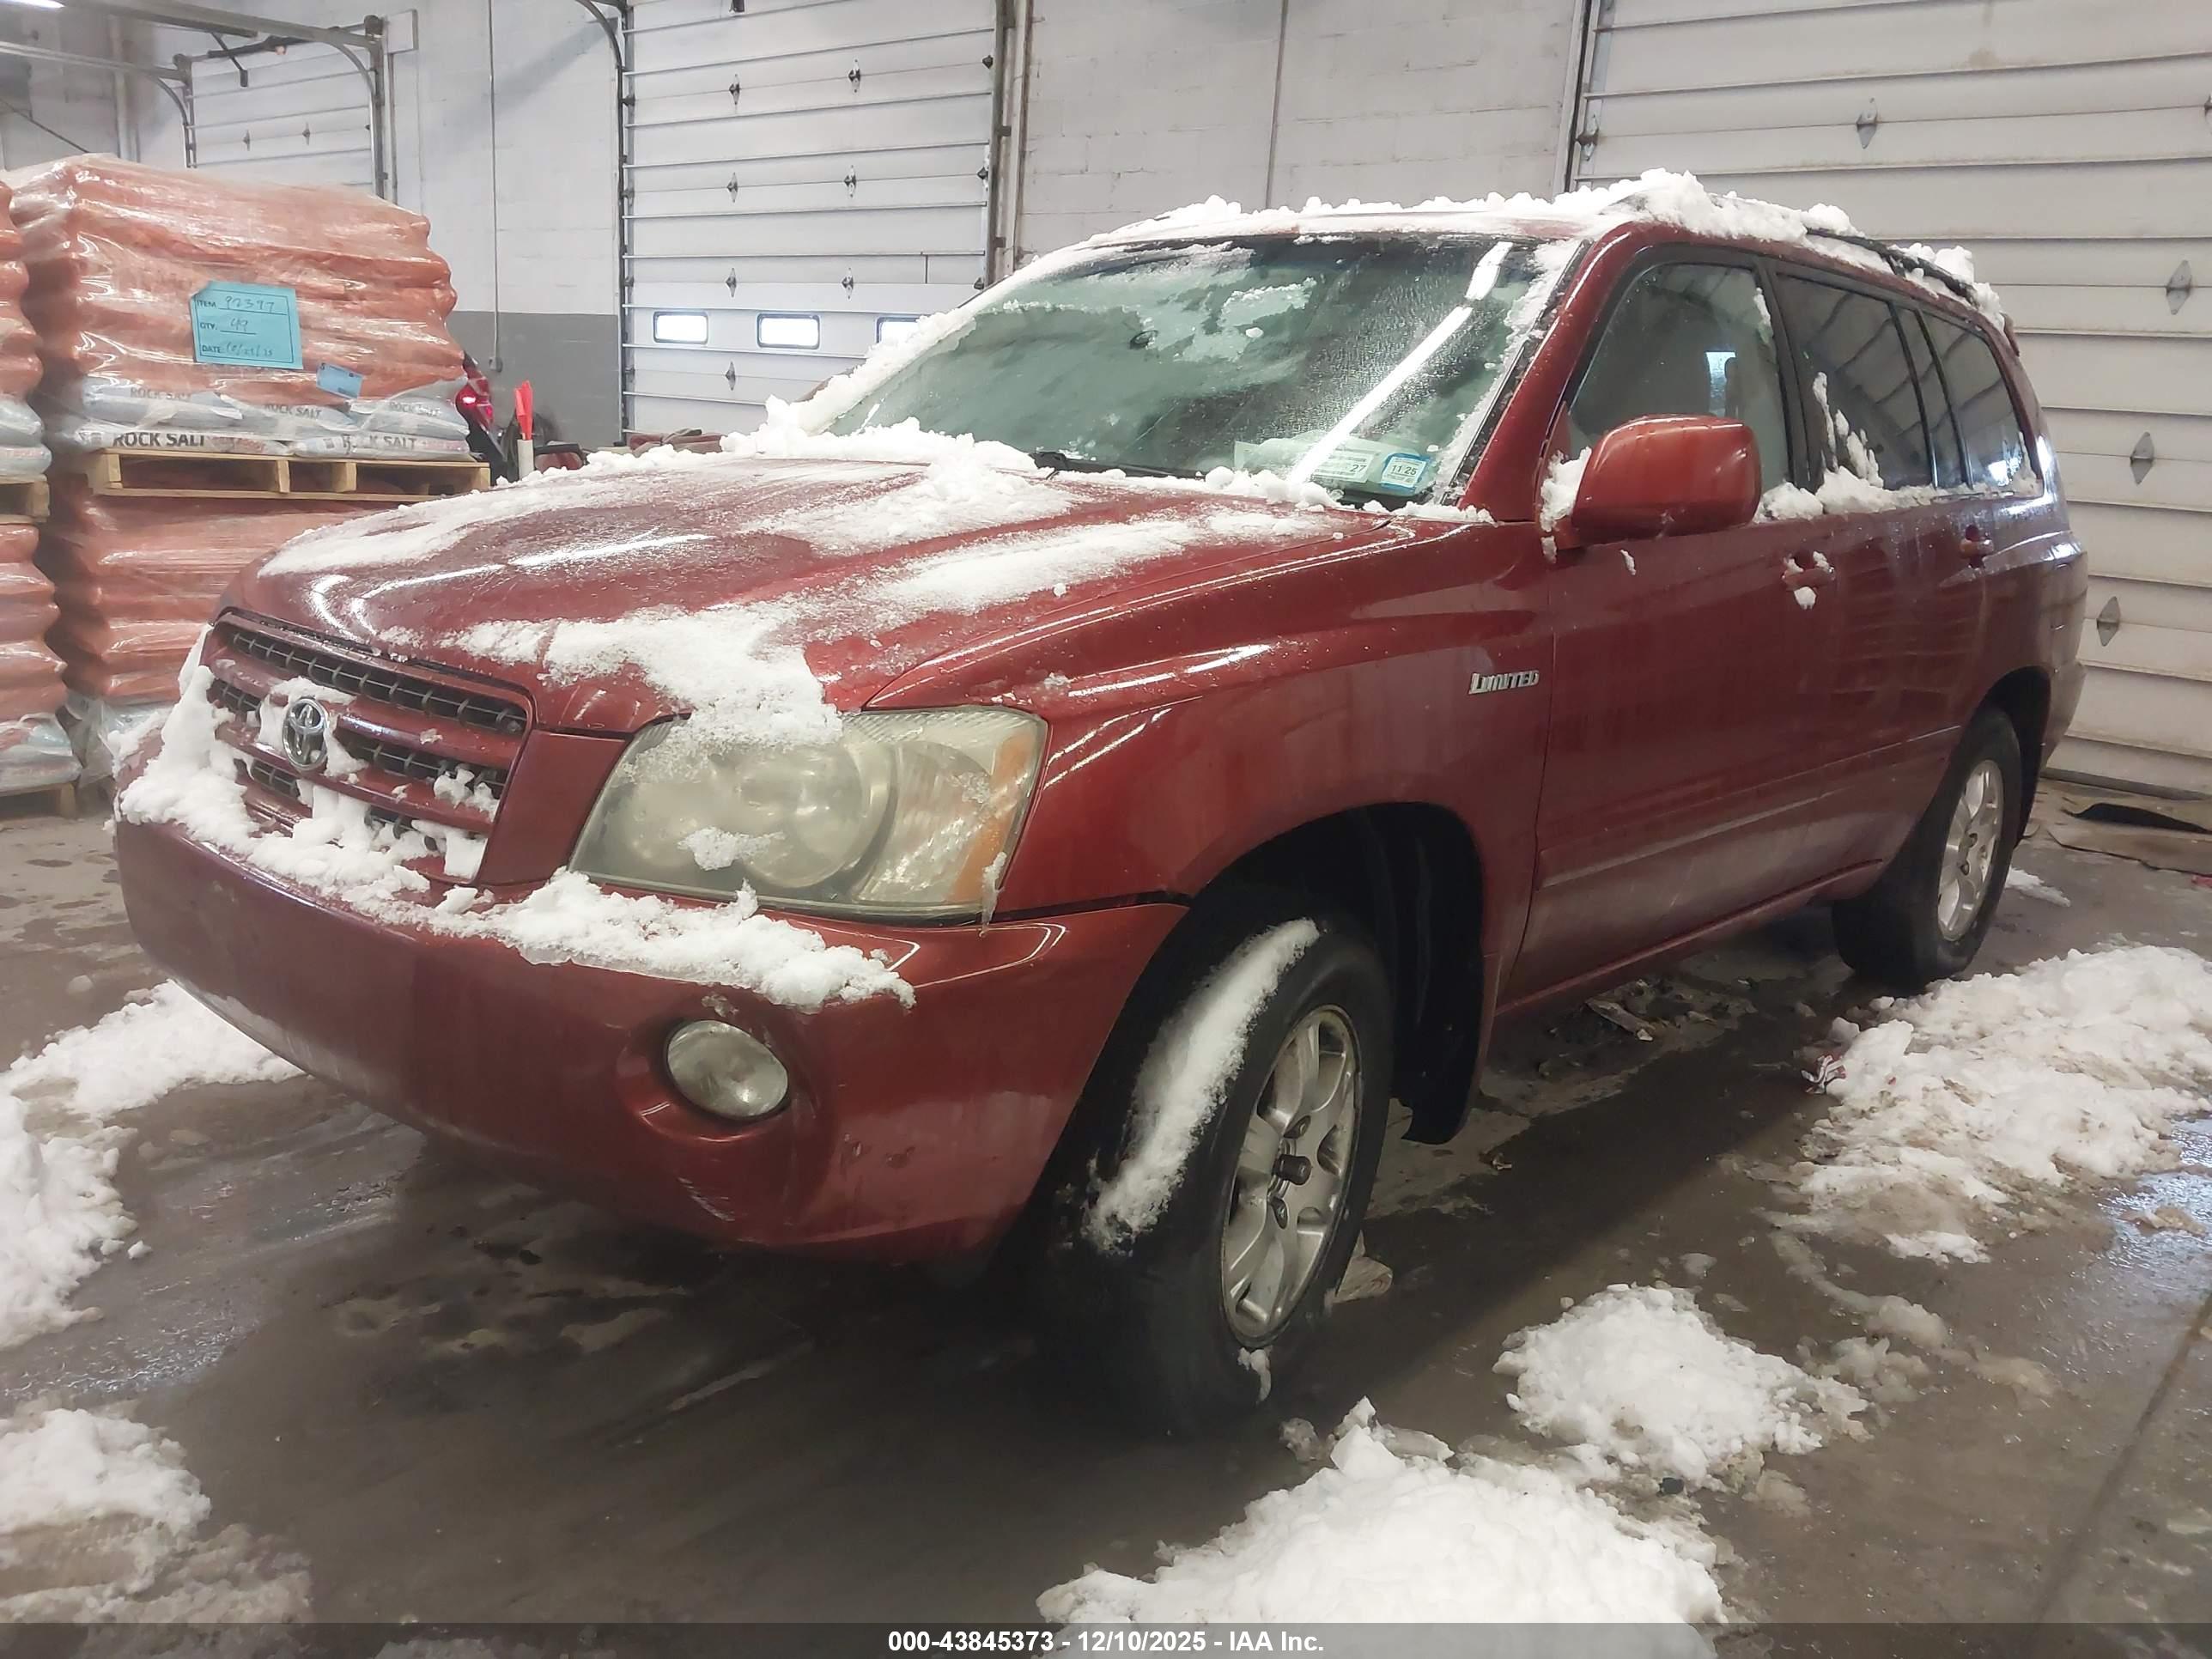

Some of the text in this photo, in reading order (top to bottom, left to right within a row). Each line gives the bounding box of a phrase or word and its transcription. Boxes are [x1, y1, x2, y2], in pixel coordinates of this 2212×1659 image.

[196, 299, 217, 308] ITEM
[295, 406, 322, 419] SALT
[112, 432, 161, 447] ROCK
[382, 435, 416, 450] SALT
[1350, 464, 1367, 472] 27
[1404, 466, 1418, 476] 25
[1468, 670, 1539, 695] LIMITED
